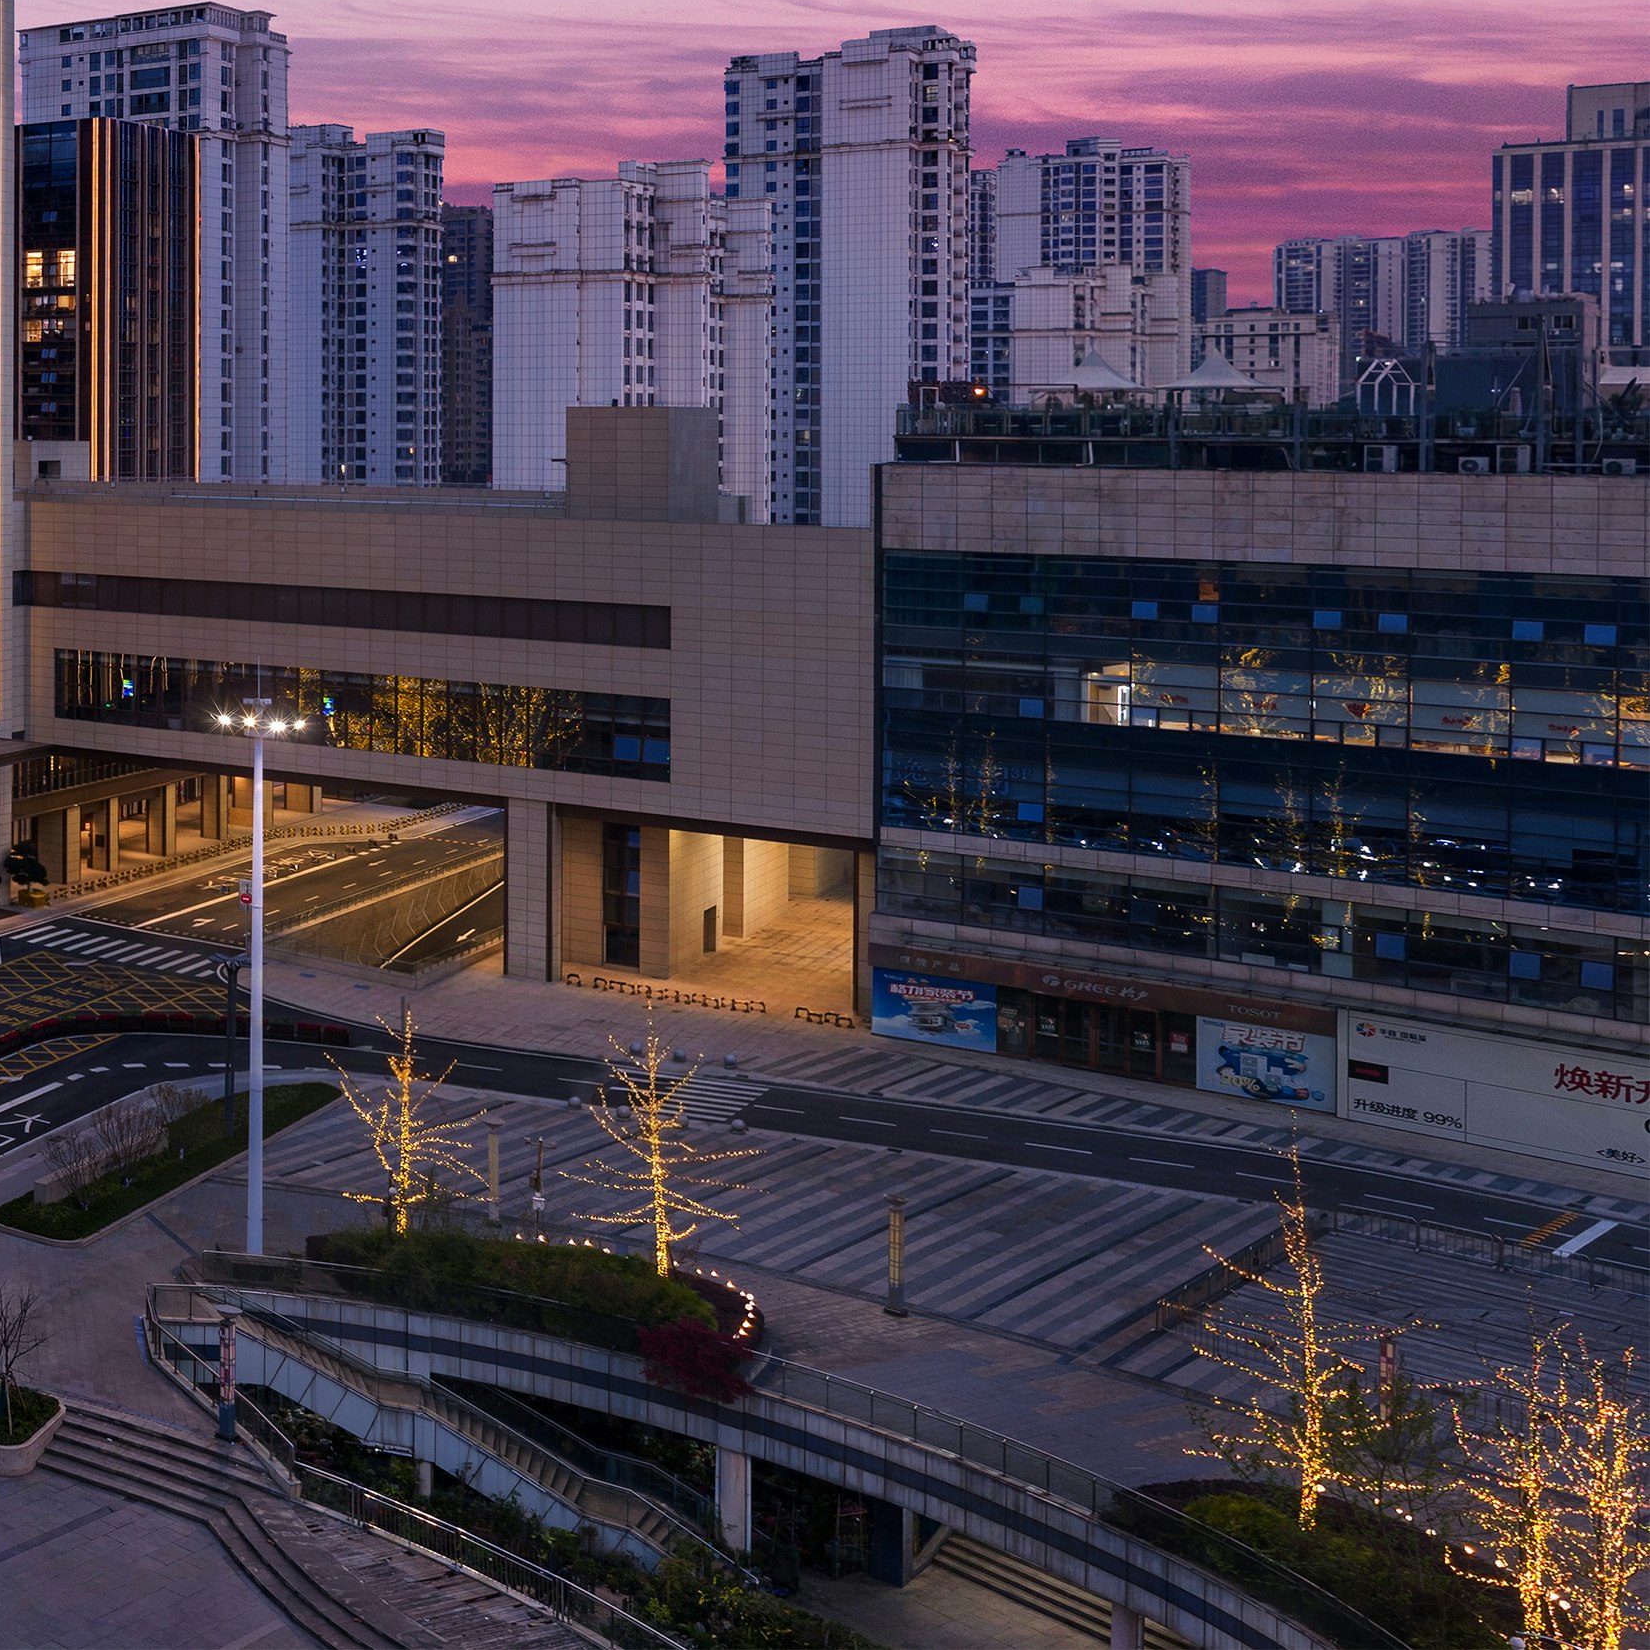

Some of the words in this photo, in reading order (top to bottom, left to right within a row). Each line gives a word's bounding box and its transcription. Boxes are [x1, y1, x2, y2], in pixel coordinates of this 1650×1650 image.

[1063, 979, 1118, 996] GREE
[1227, 1004, 1282, 1019] TOSOT
[1222, 1026, 1306, 1052] 家装节
[1353, 1098, 1418, 1121] 升级进度
[1423, 1111, 1462, 1129] 99%
